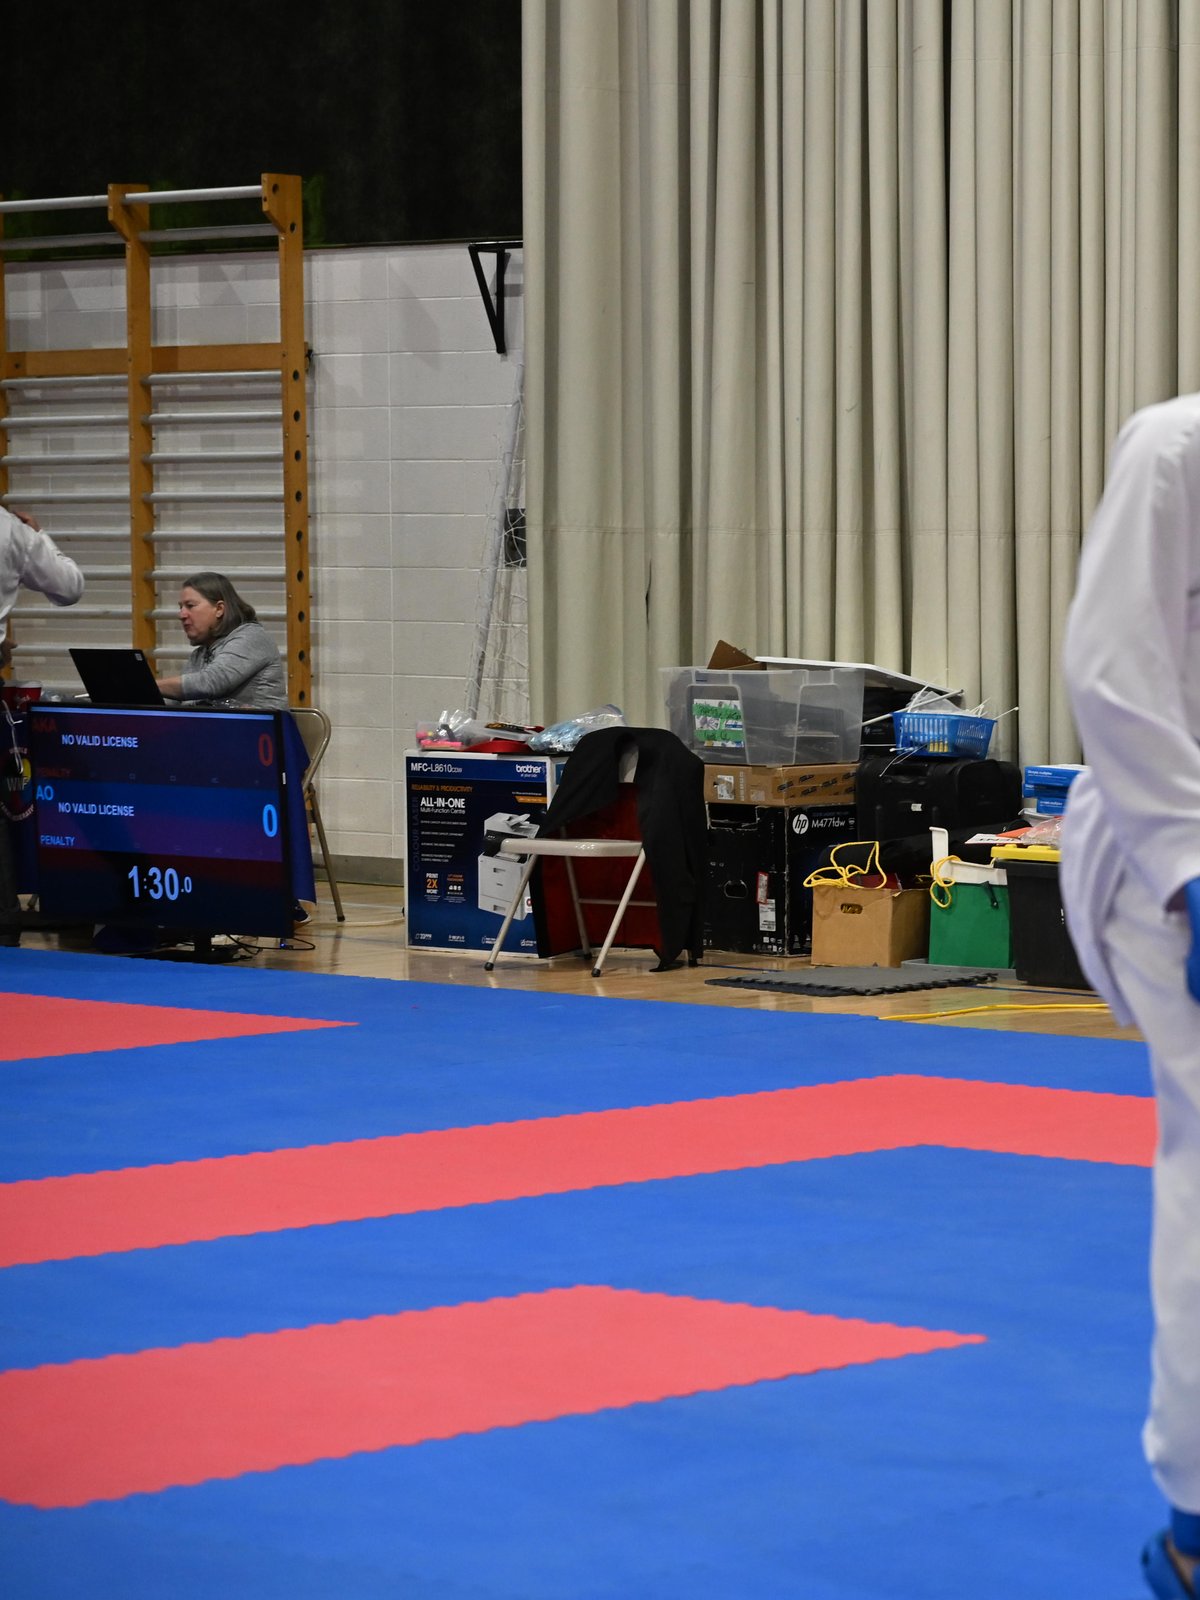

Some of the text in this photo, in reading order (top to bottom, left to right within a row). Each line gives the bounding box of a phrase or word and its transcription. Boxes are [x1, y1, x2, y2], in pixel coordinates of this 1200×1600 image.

[61, 733, 139, 748] NO VALID LICENSE
[258, 733, 274, 766] 0
[515, 763, 542, 774] brother
[36, 785, 54, 801] AO
[58, 802, 135, 817] NO VALID LICENSE
[420, 796, 466, 808] ALL-IN-ONE
[262, 803, 278, 838] 0
[792, 813, 809, 835] hp
[40, 834, 75, 847] PENALTY
[426, 878, 438, 889] 2X
